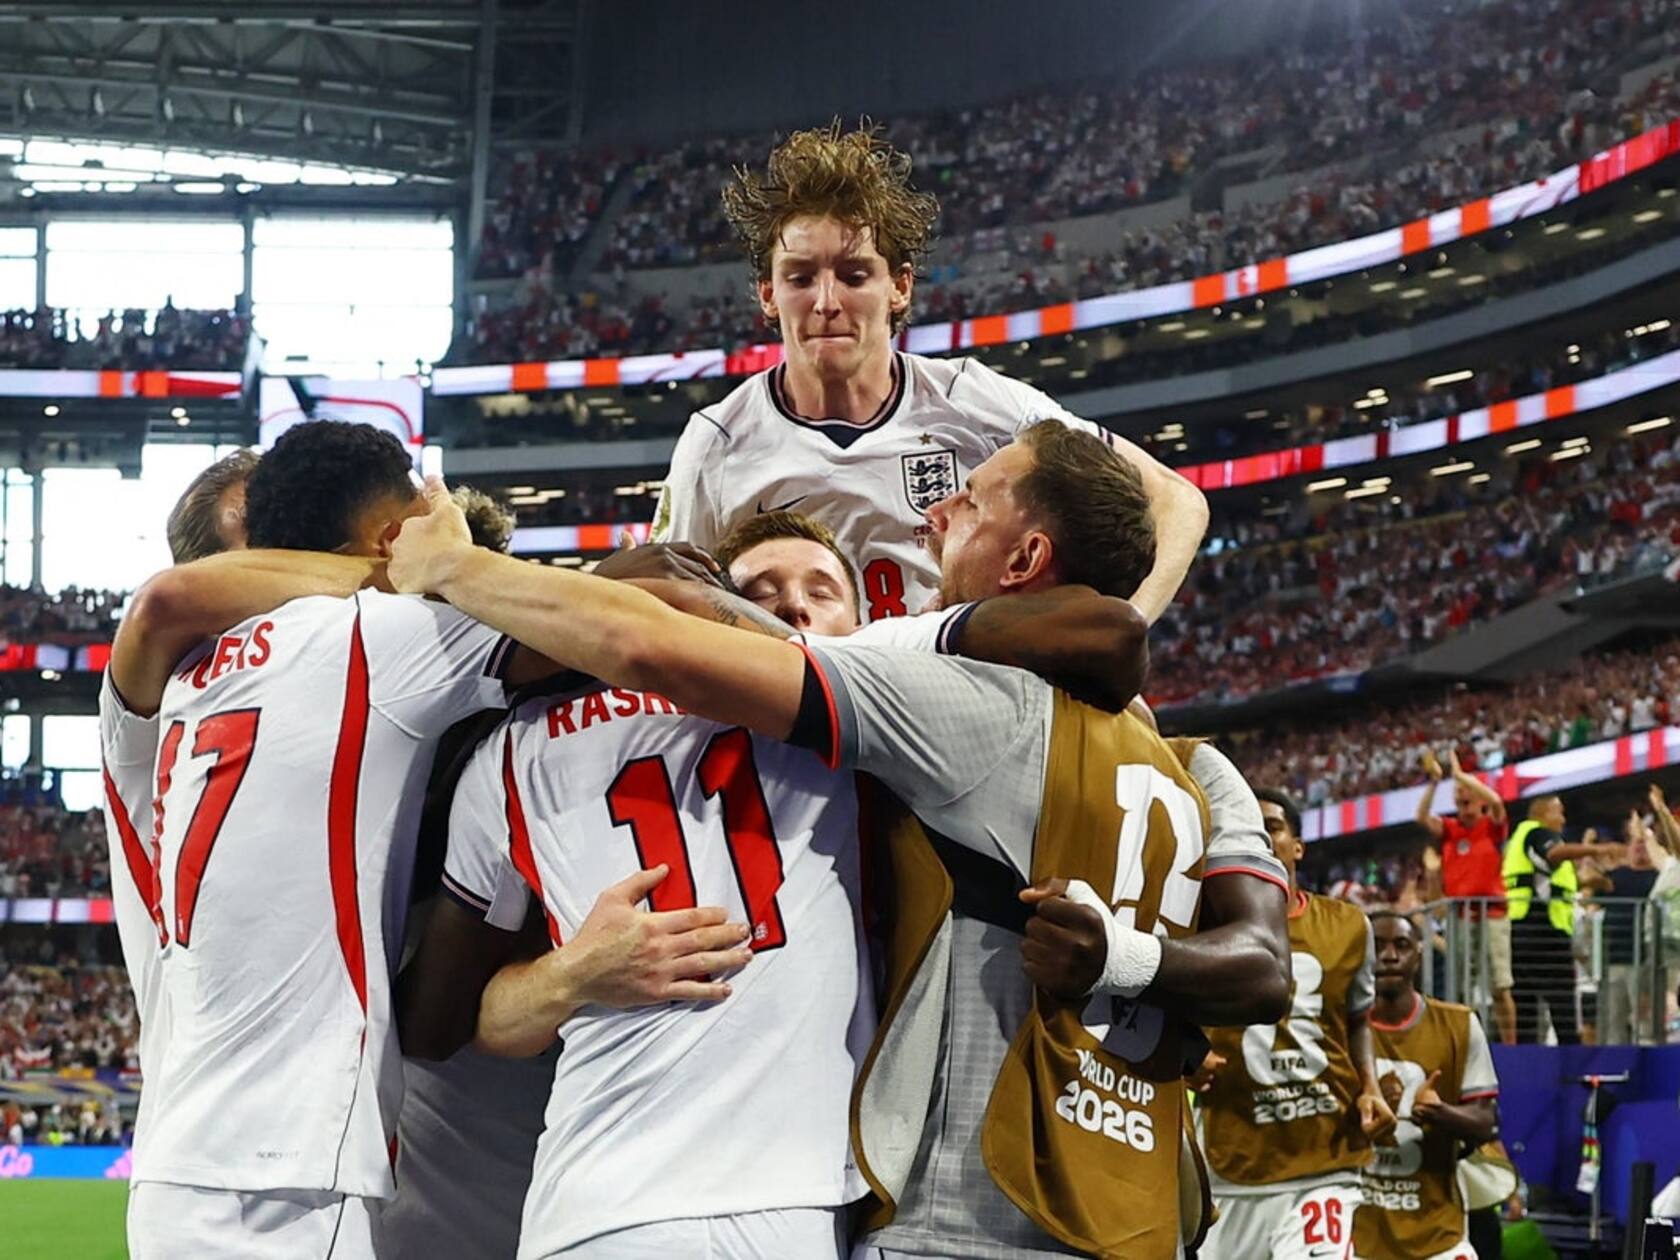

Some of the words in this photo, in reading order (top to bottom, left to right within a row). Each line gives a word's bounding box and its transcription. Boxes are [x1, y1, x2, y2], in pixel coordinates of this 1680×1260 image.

[546, 686, 689, 739] RASH
[605, 726, 787, 954] 11
[1075, 1048, 1117, 1092] WRLD
[1117, 1074, 1156, 1106] CUP
[1055, 1079, 1156, 1152] 2026
[1253, 1095, 1341, 1124] 2026
[1301, 1198, 1342, 1245] 26
